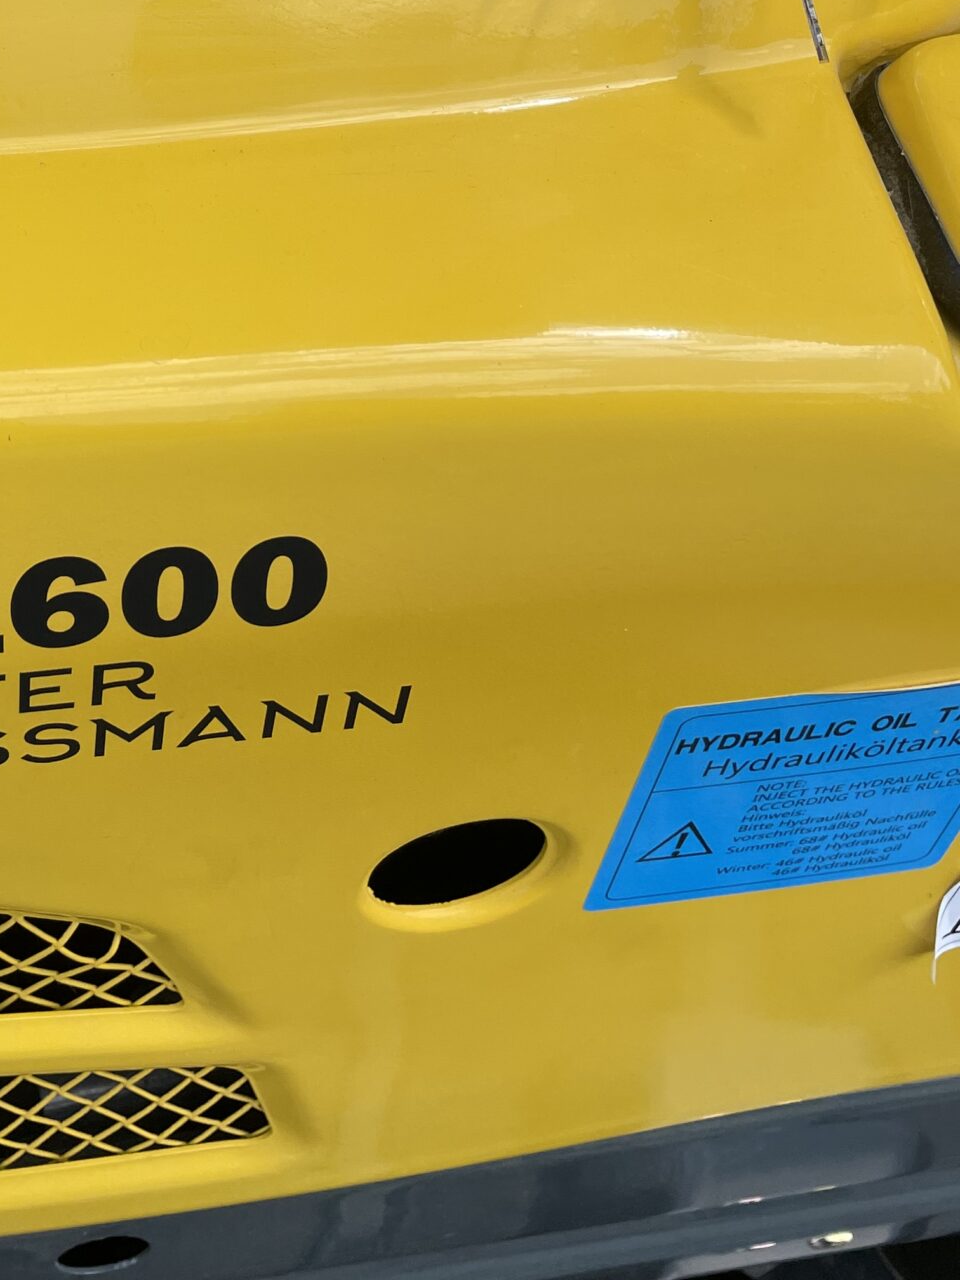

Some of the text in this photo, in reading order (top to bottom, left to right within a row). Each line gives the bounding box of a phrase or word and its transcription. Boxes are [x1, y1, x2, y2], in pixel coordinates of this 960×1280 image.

[674, 720, 857, 755] HYDRAULIC
[871, 712, 917, 732] OIL
[702, 729, 960, 780] Hydrauliköltank
[746, 793, 848, 812] ACCORDING
[855, 789, 876, 800] TO
[882, 785, 912, 796] THE
[753, 788, 808, 802] INJECT
[814, 784, 846, 794] THE
[849, 771, 942, 791] HYDRAULIC
[738, 823, 774, 832] Bitte
[832, 825, 905, 841] Hydraulic
